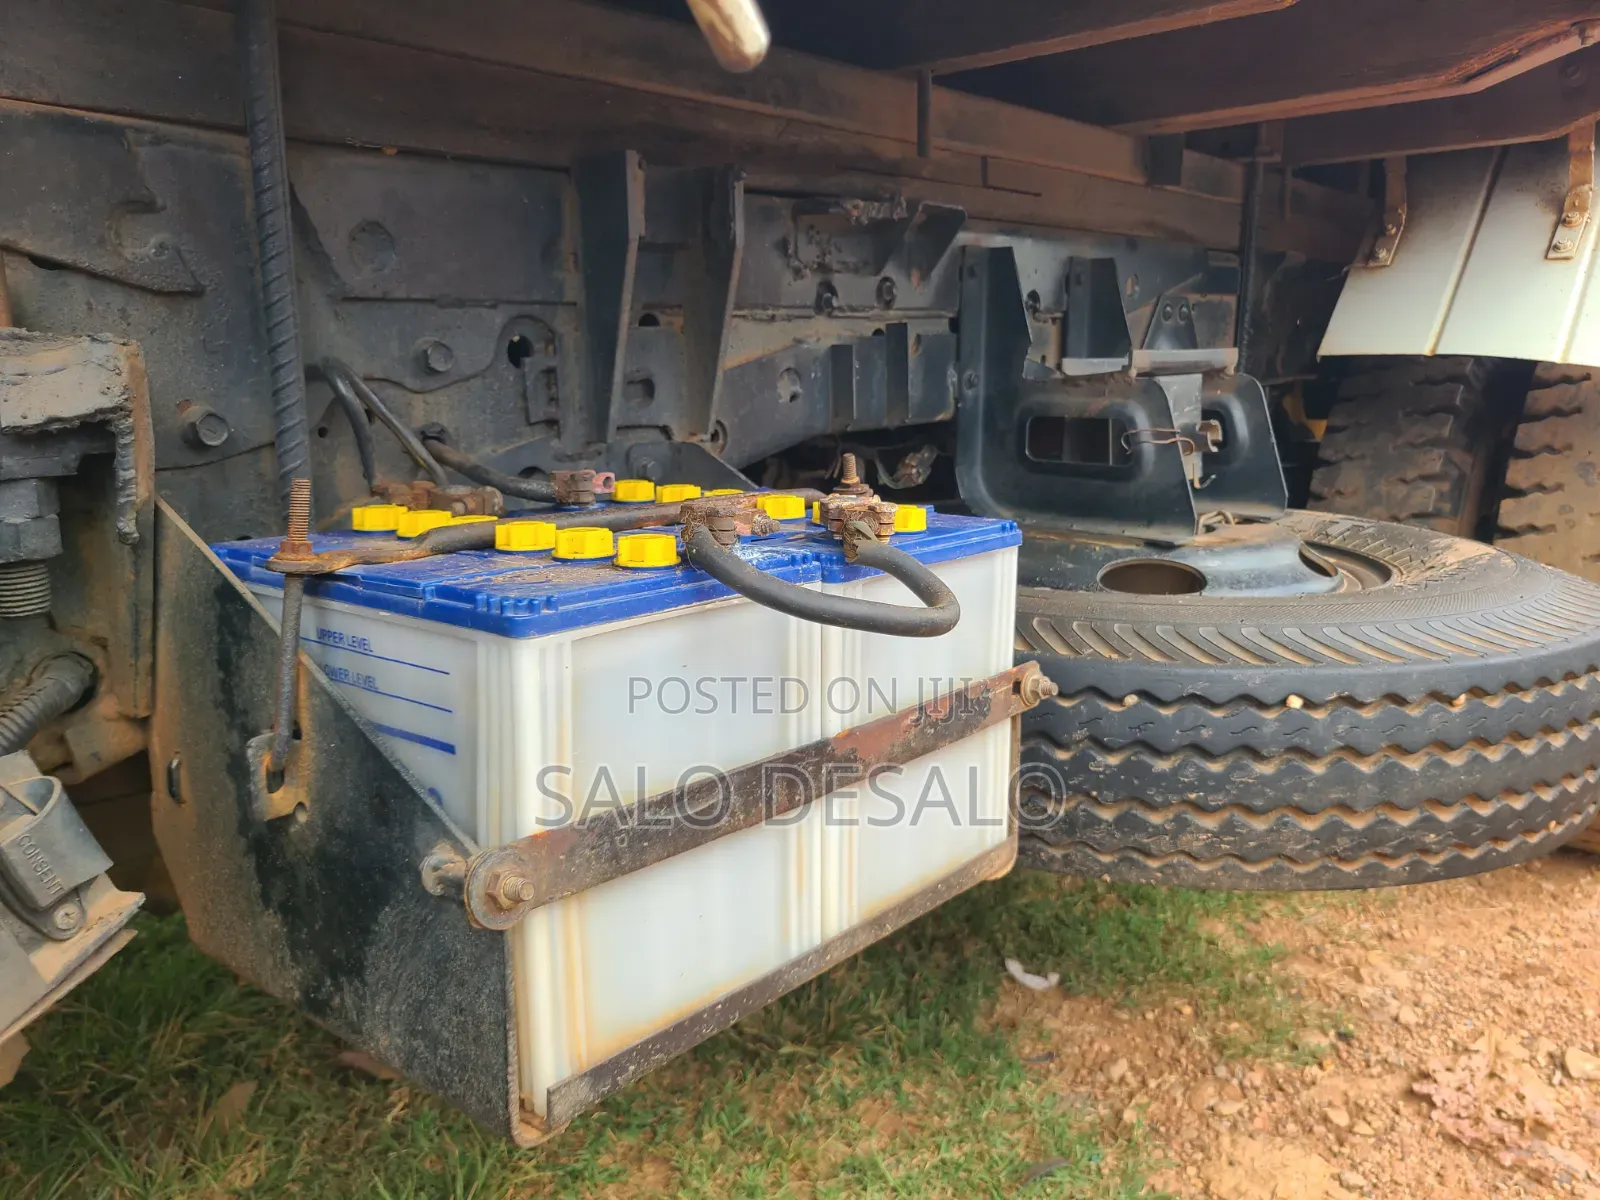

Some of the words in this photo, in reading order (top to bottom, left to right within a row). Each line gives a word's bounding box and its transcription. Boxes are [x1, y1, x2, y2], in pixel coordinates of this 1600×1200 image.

[318, 628, 345, 646] UPPER
[346, 635, 374, 653] LEVEL
[351, 671, 378, 689] LEVEL
[18, 833, 66, 896] CONSENT
